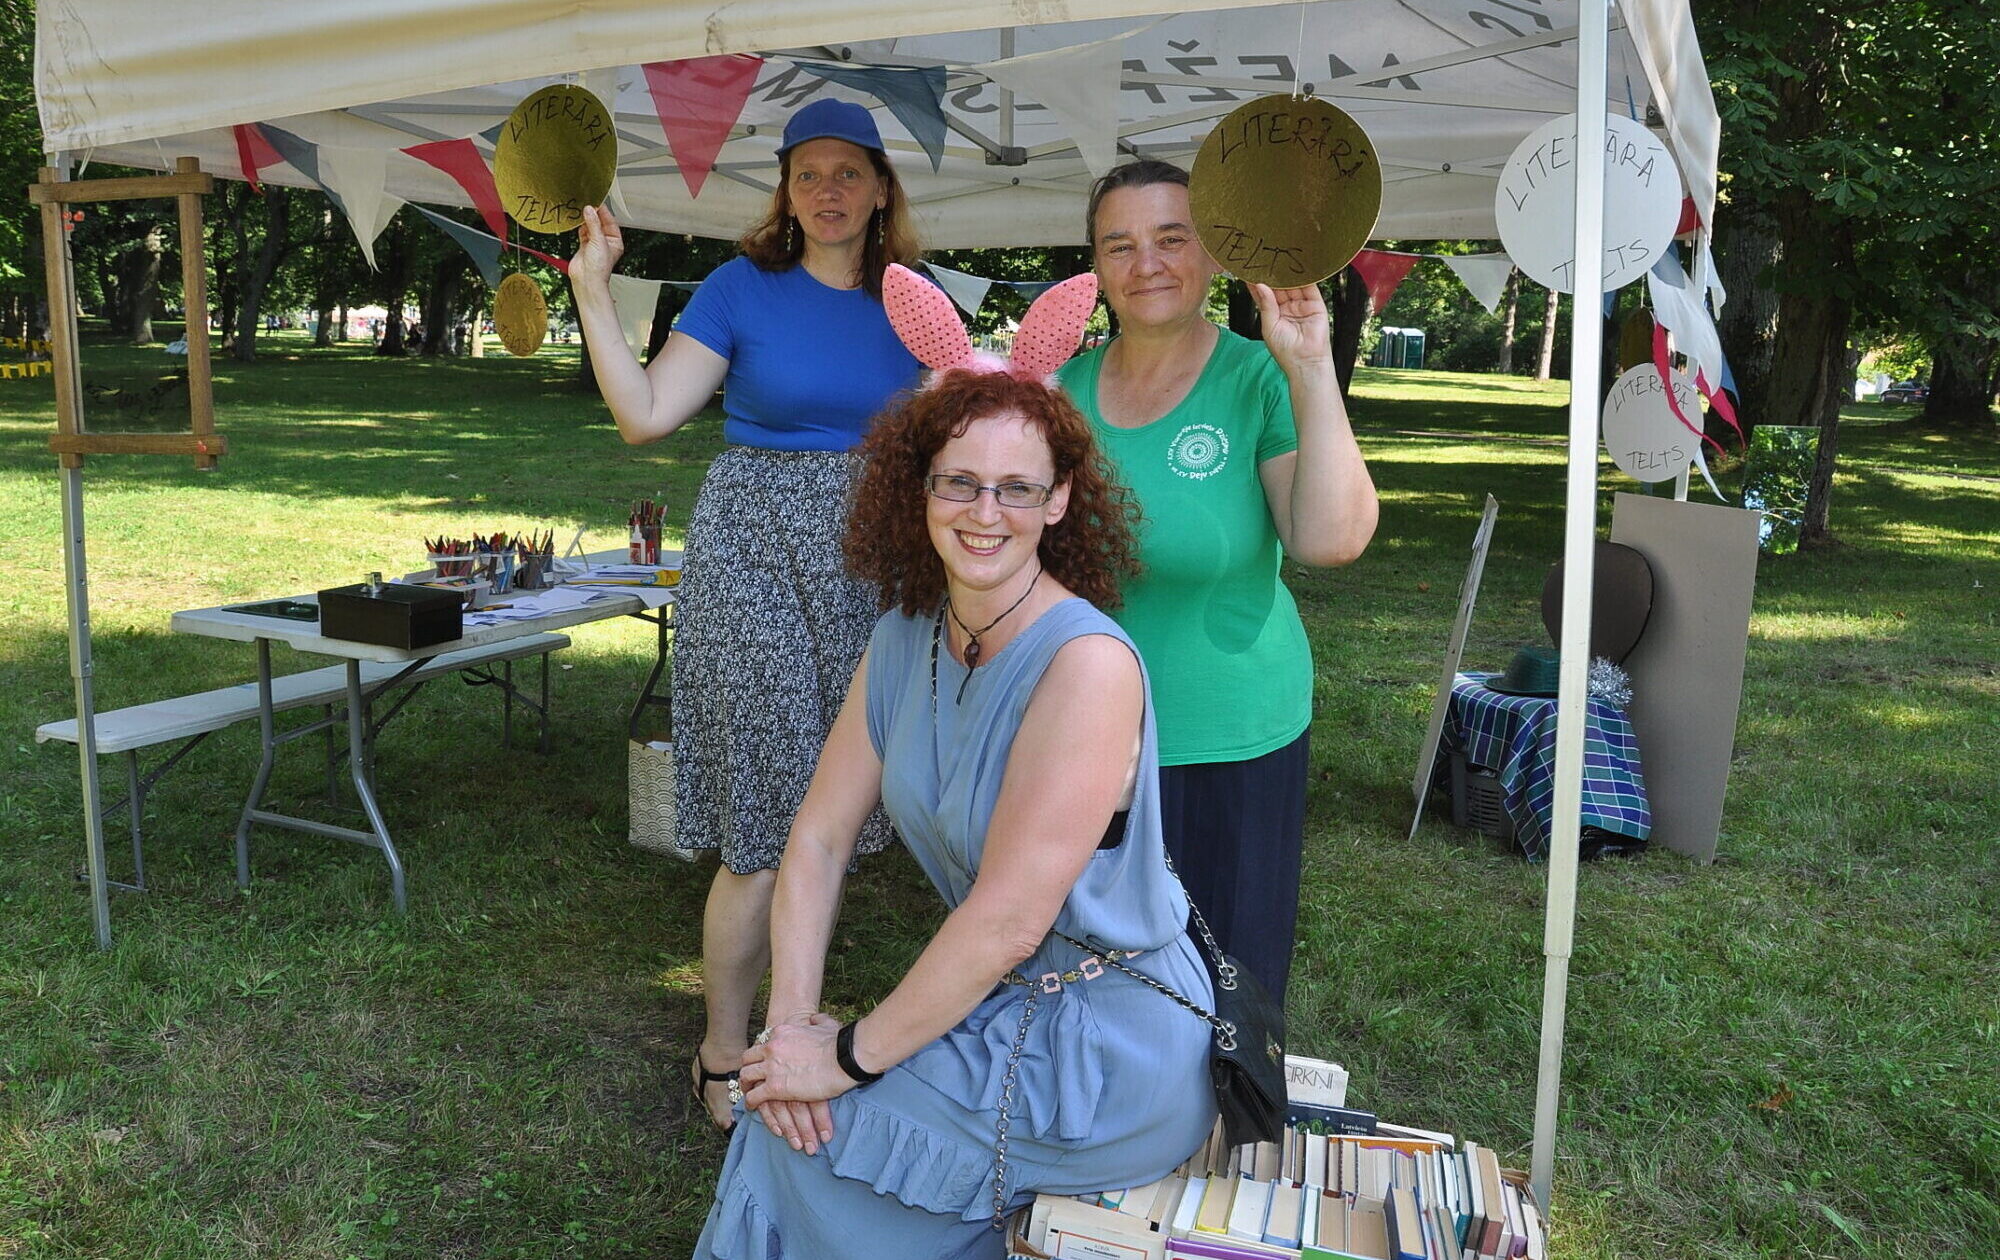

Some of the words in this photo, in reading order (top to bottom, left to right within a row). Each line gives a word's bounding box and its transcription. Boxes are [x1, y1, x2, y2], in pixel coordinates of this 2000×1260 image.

[510, 95, 614, 151] LITERĀRĀ
[1505, 129, 1663, 212] LITEĀRĀ
[517, 195, 583, 225] TELTS
[1214, 225, 1305, 277] TELTS
[1552, 239, 1650, 289] TTS
[1626, 444, 1684, 470] TELTS
